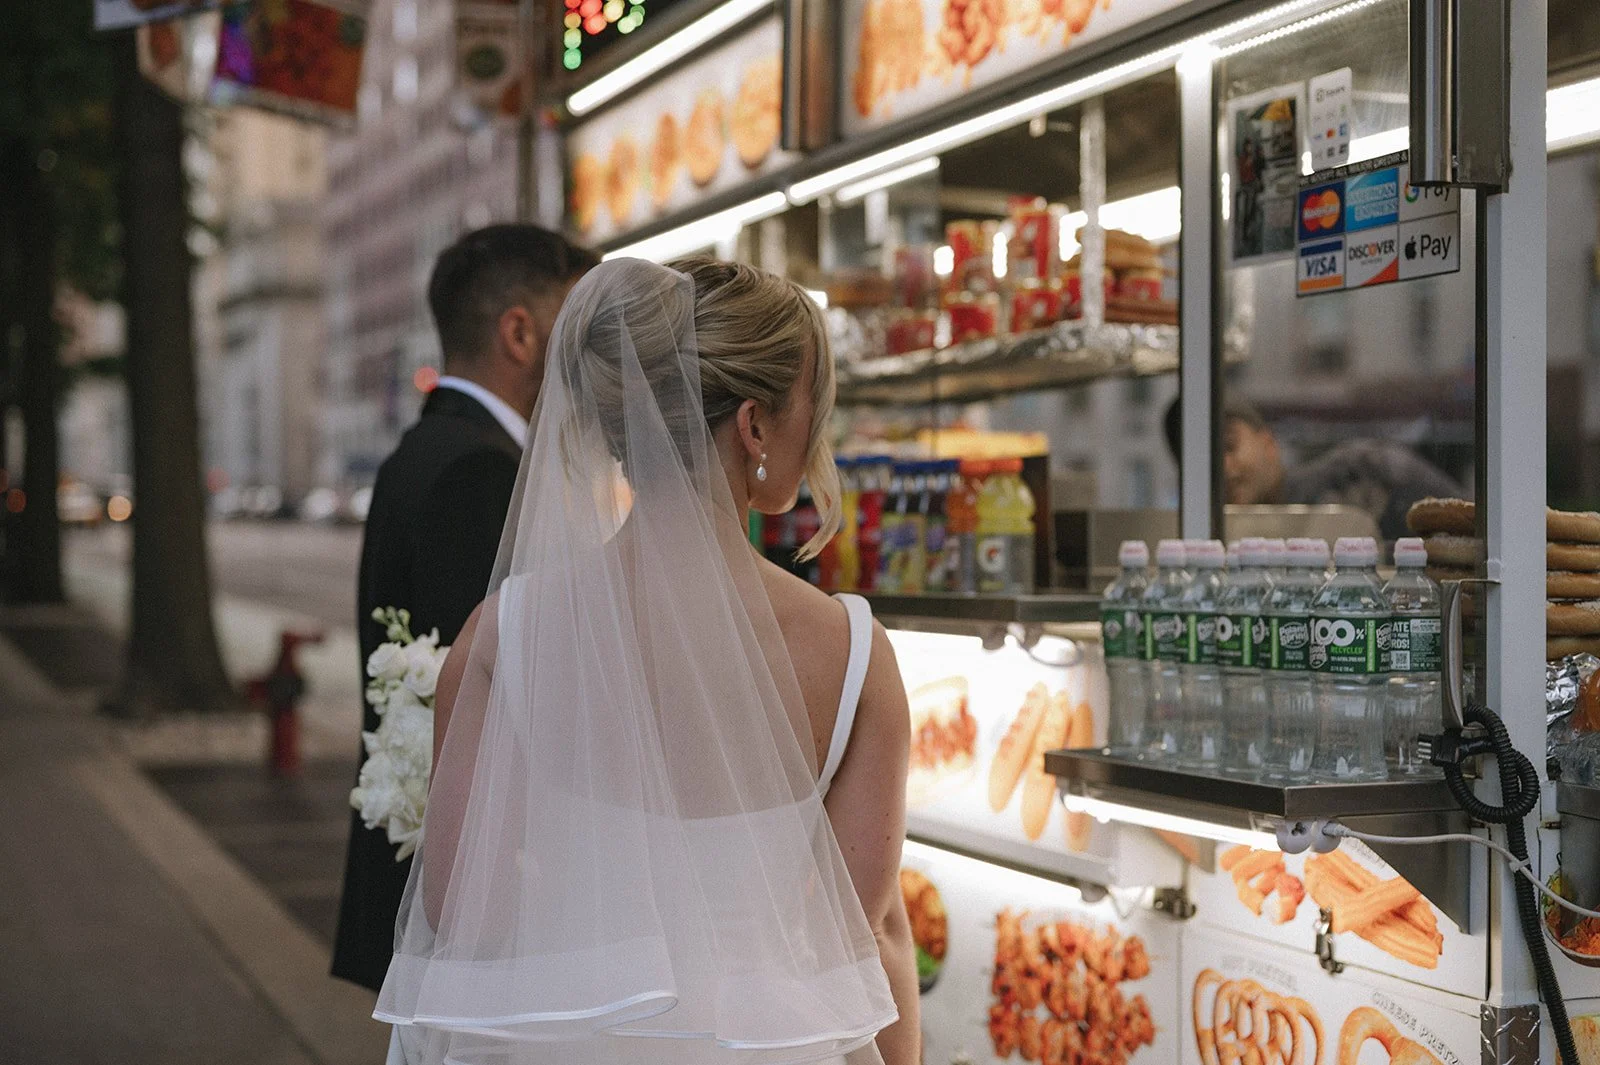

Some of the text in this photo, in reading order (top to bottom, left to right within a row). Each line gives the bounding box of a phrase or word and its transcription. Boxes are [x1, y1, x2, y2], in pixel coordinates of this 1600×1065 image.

[1348, 239, 1395, 261] DISCOVER
[1420, 234, 1451, 260] Pay
[1306, 255, 1337, 277] VISA
[1309, 618, 1365, 646] 100%
[1330, 646, 1363, 655] RECYCLED
[1373, 991, 1418, 1031] CHEESE
